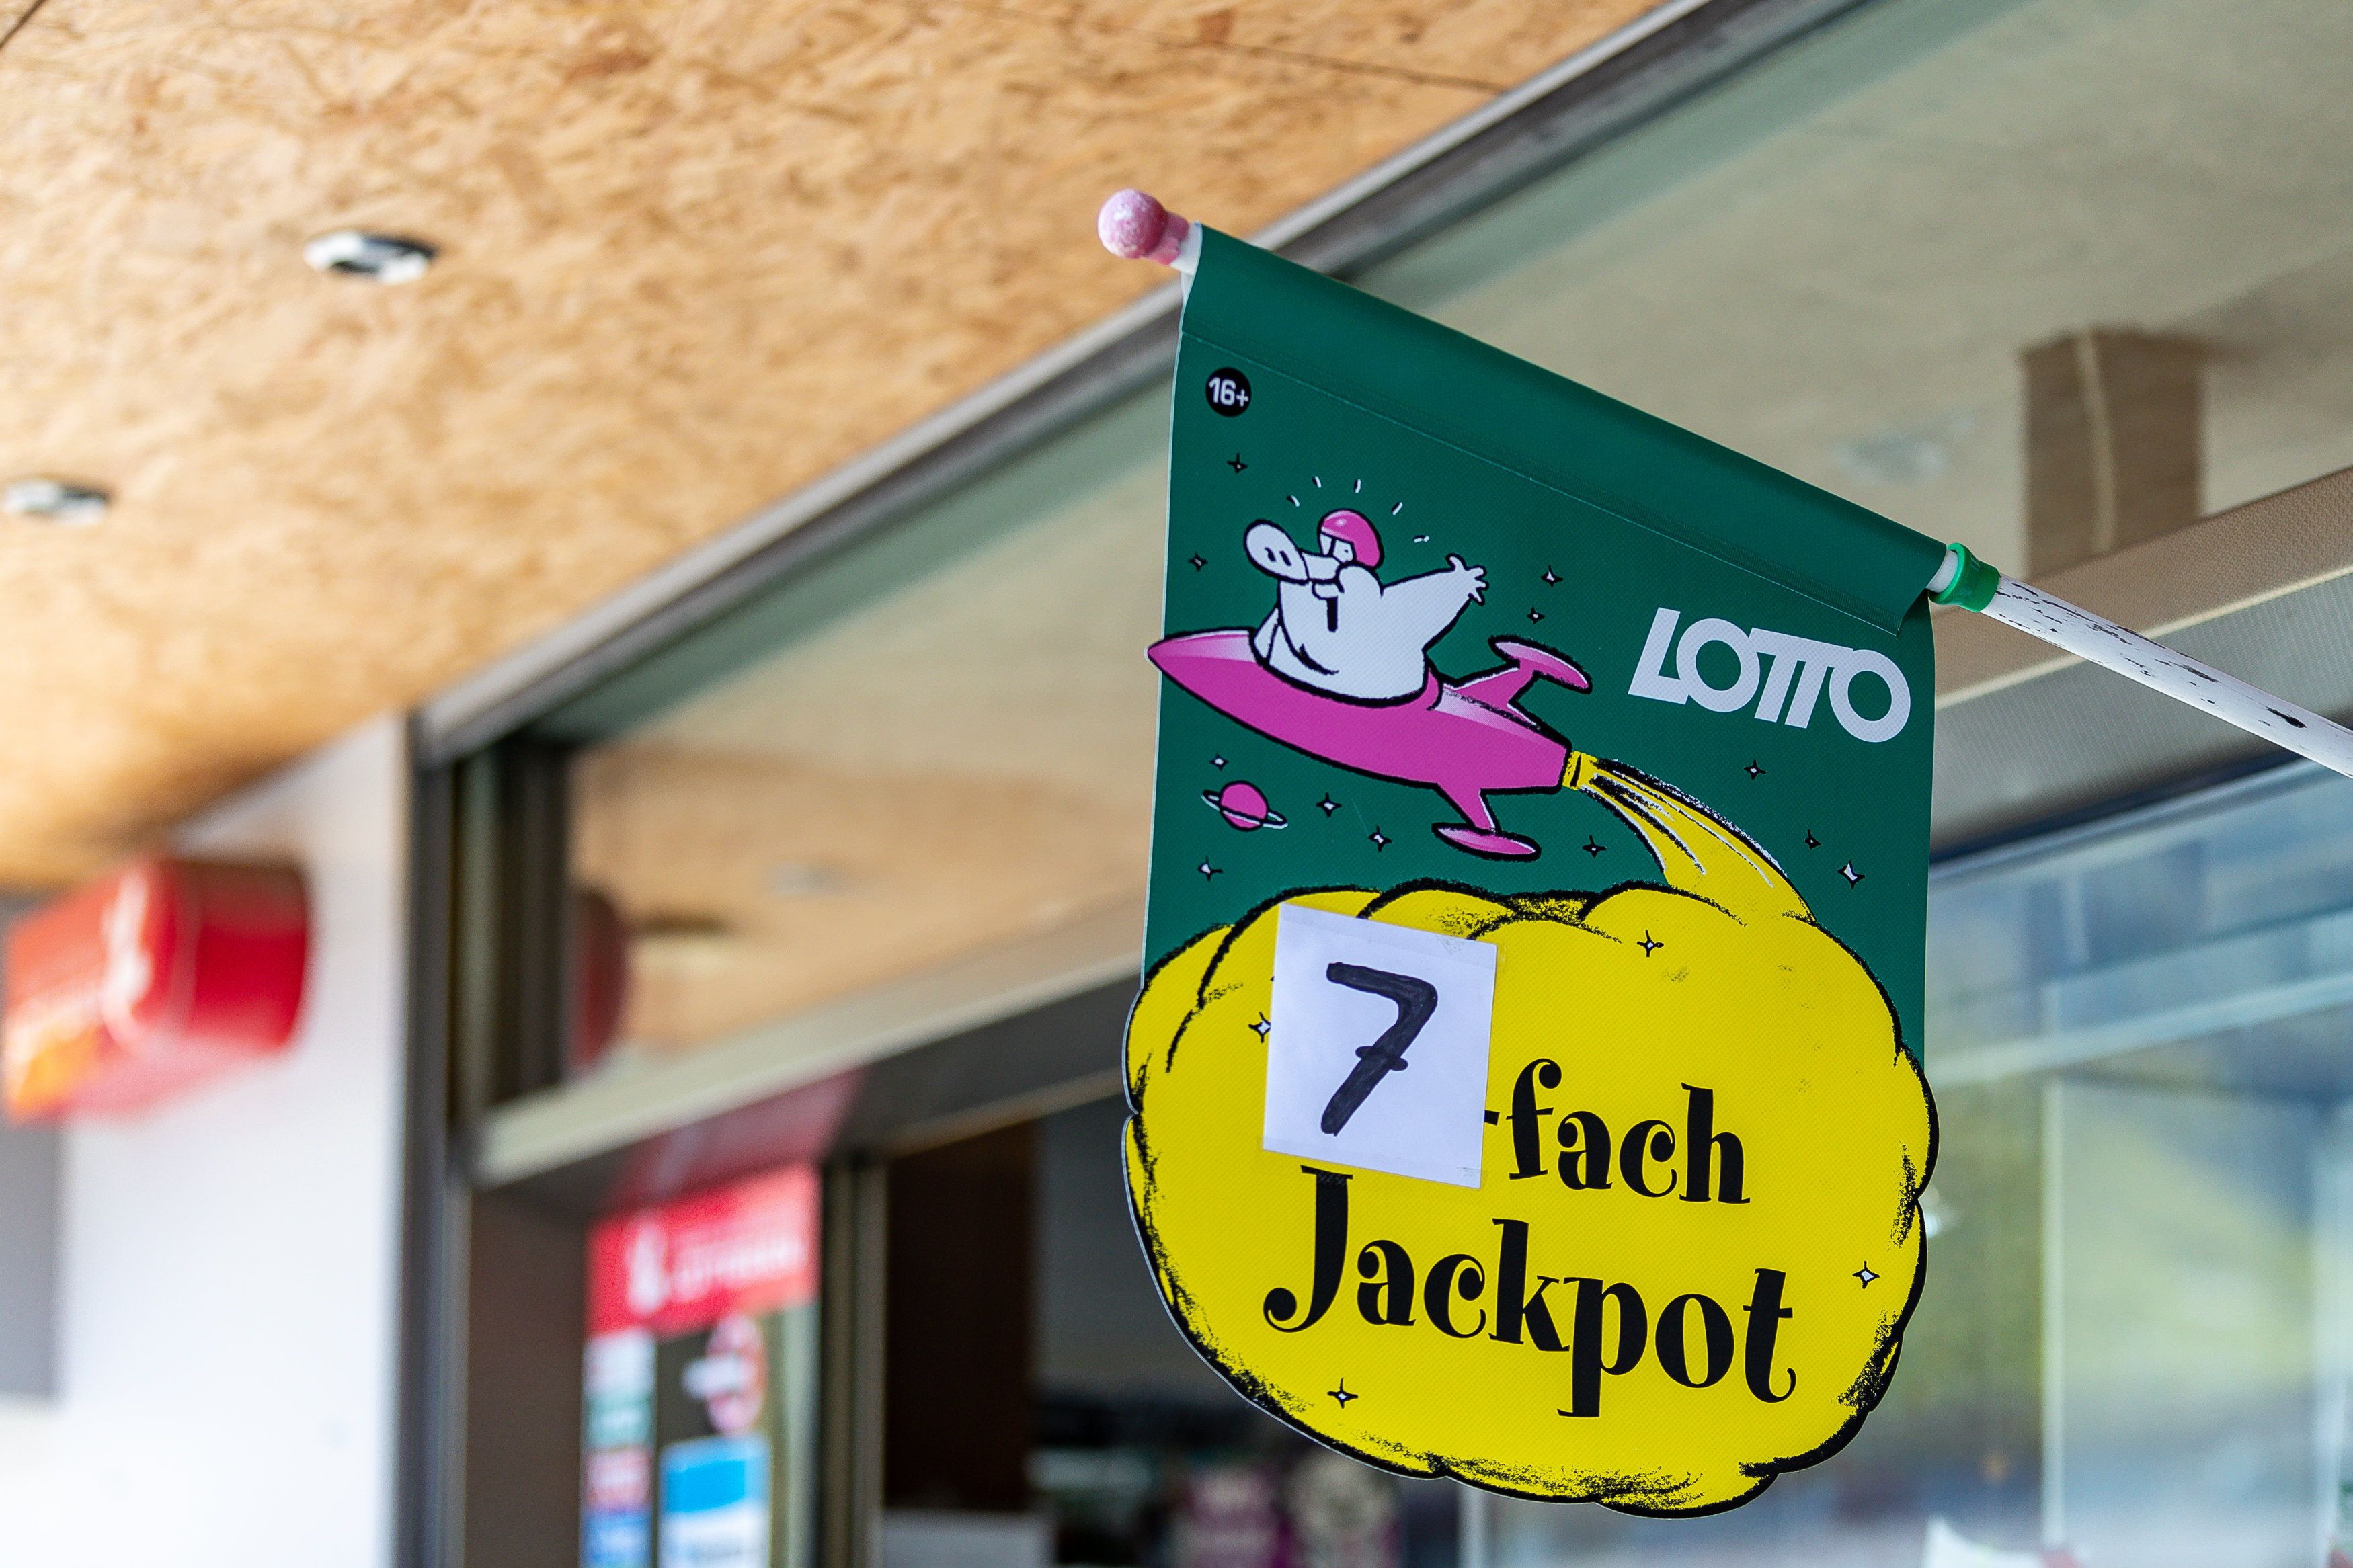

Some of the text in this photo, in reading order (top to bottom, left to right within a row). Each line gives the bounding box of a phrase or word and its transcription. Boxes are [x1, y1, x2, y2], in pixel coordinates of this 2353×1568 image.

[1208, 377, 1249, 407] 16+
[1628, 607, 1911, 742] LOTTO
[1321, 962, 1438, 1136] 7
[1263, 1165, 1796, 1418] Jackpot
